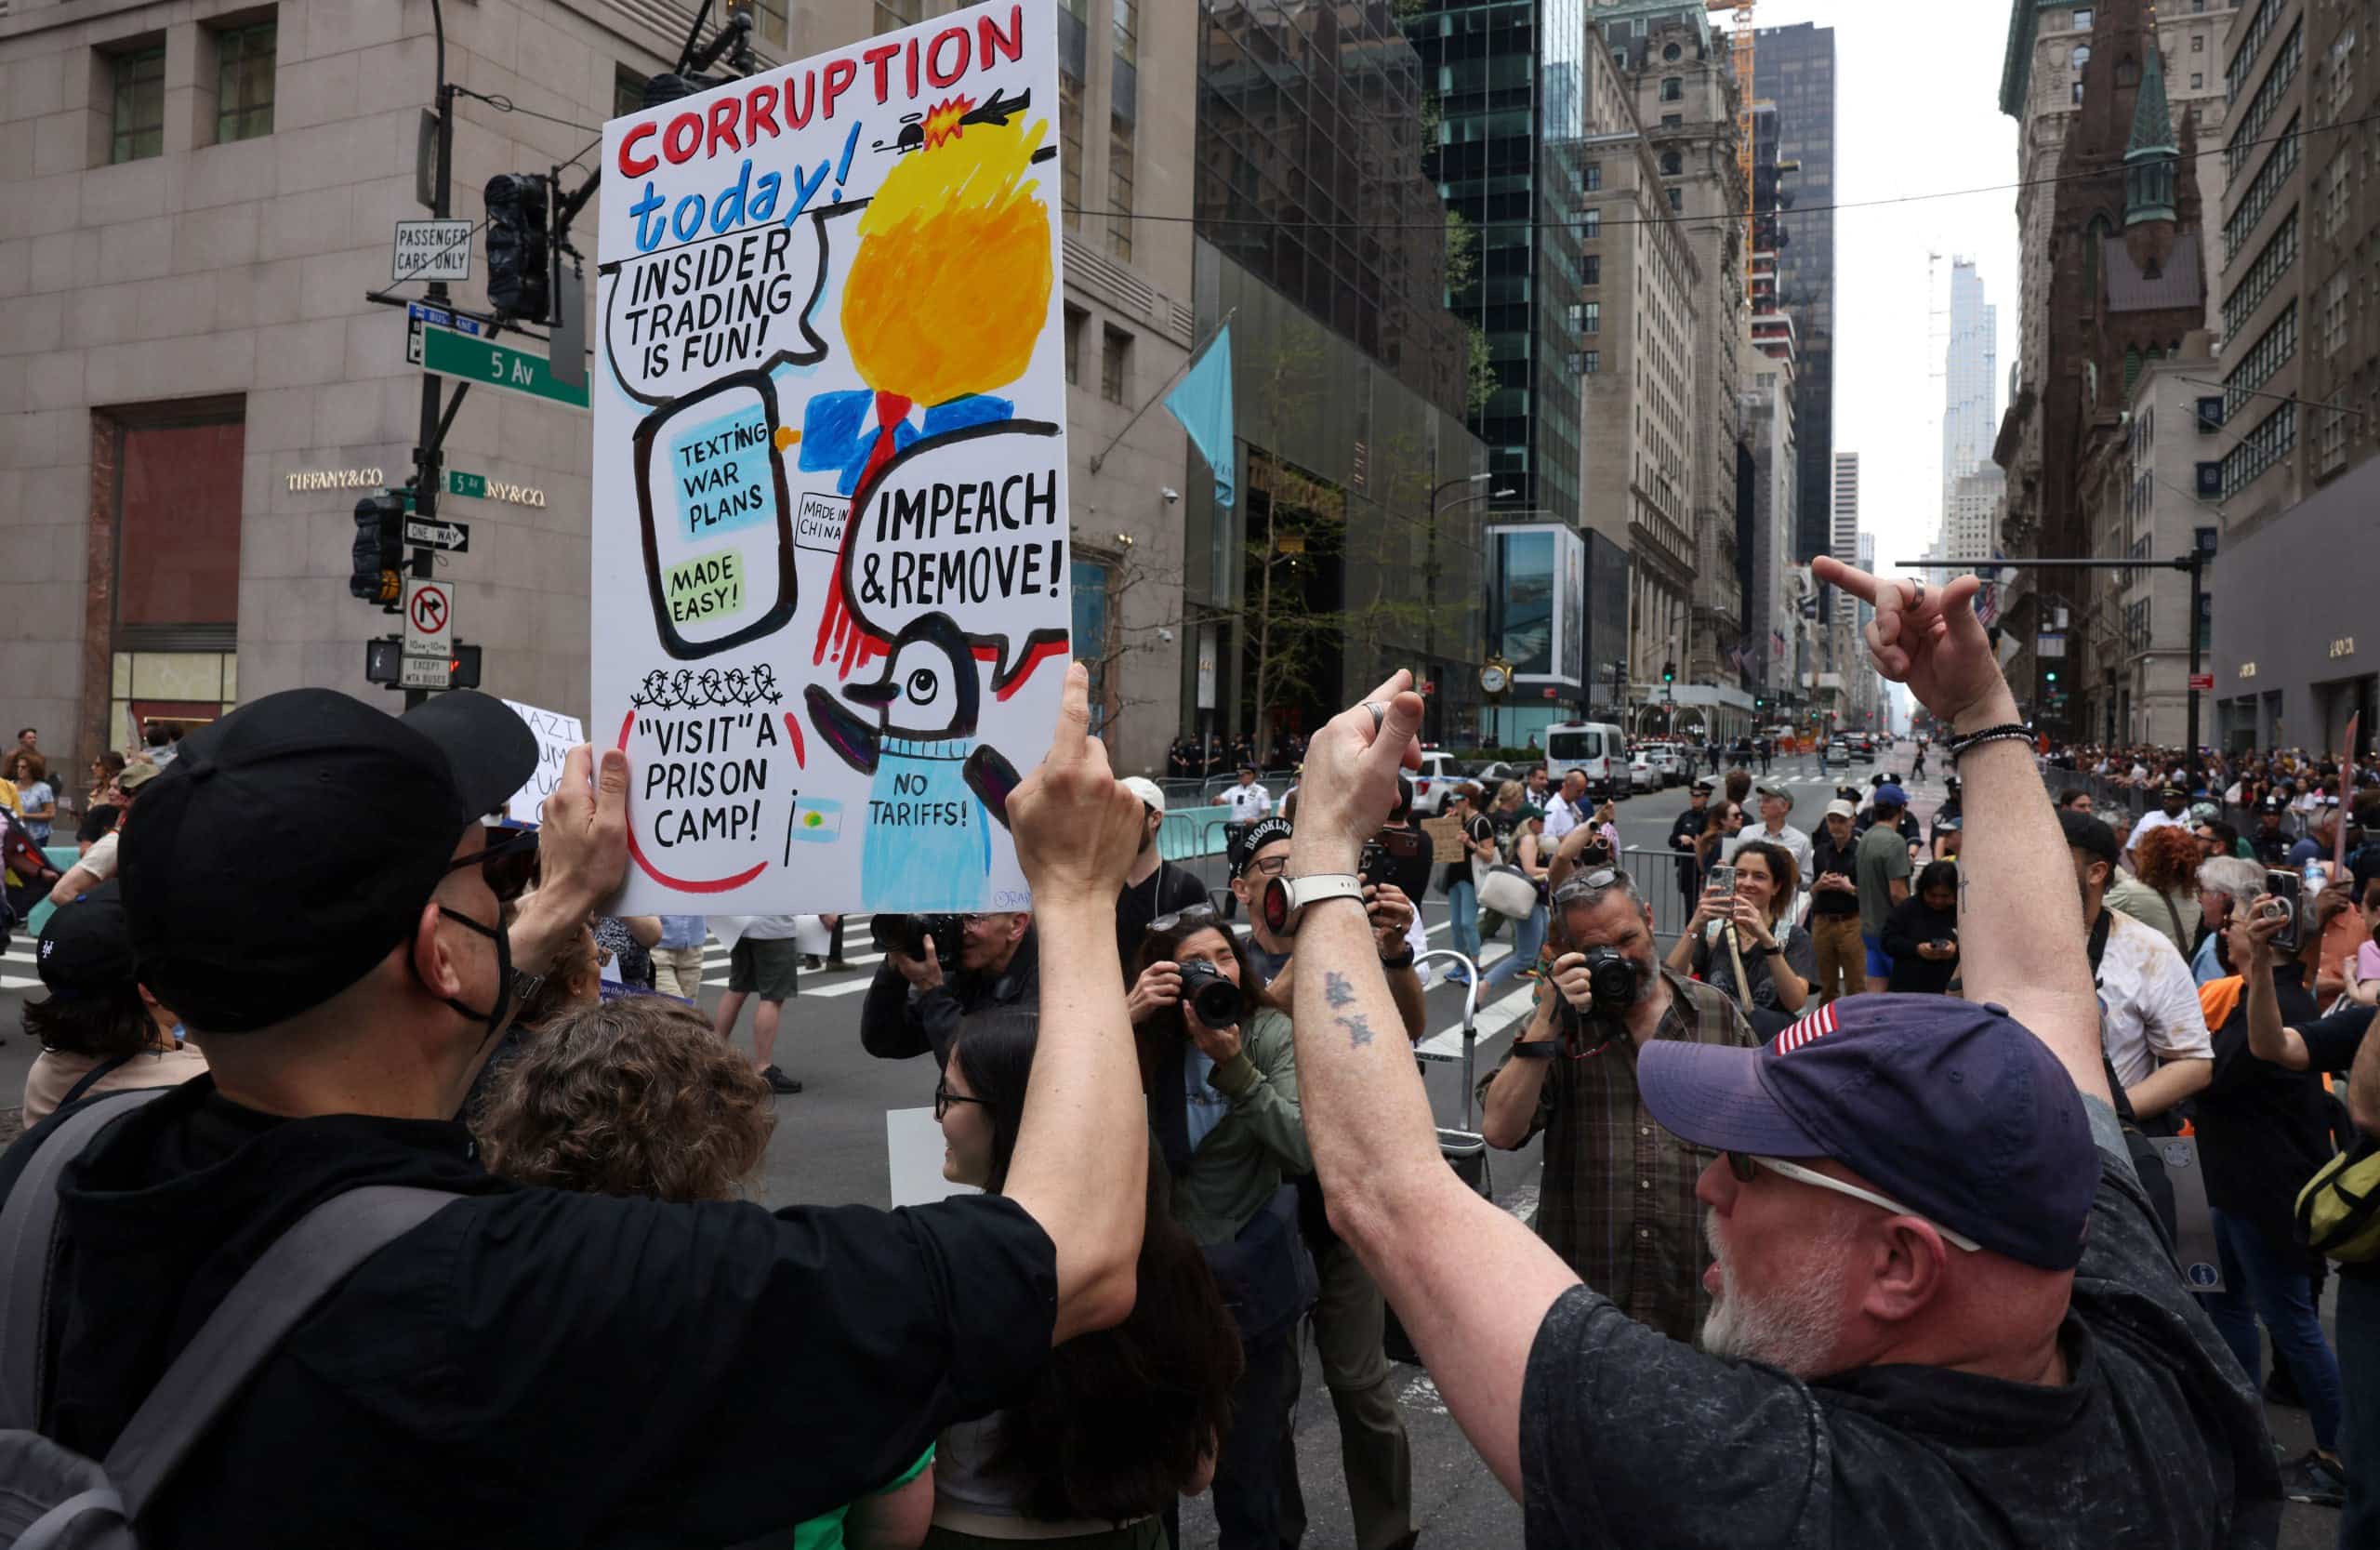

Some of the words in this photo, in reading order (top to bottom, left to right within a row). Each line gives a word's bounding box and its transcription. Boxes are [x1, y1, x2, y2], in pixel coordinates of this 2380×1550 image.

[618, 4, 1024, 179] CORRUPTION
[629, 120, 862, 253] today!
[399, 229, 468, 246] PASSENGER
[397, 252, 428, 270] CARS
[435, 252, 466, 270] ONLY
[630, 229, 791, 307] INSIDER
[625, 273, 792, 345] TRADING
[641, 343, 669, 379] IS
[681, 314, 771, 372] FUN!
[491, 351, 504, 378] 5
[510, 358, 535, 386] Av
[456, 475, 465, 492] 5
[683, 461, 740, 498] WAR
[690, 484, 763, 533] PLANS
[803, 500, 836, 521] MADE
[838, 508, 850, 522] IN
[875, 469, 1057, 543] IMPEACH
[412, 525, 428, 539] ONE
[436, 527, 459, 543] WAY
[800, 519, 841, 540] CHINA
[670, 555, 734, 597] MADE
[673, 583, 737, 622] EASY!
[413, 661, 440, 670] EXCEPT
[423, 675, 447, 685] BUSES
[756, 719, 778, 747] A
[645, 759, 767, 800] PRISON
[893, 773, 928, 797] NO
[654, 800, 760, 847] CAMP!
[869, 800, 968, 827] TARIFFS!
[1244, 819, 1294, 851] BROOKLYN
